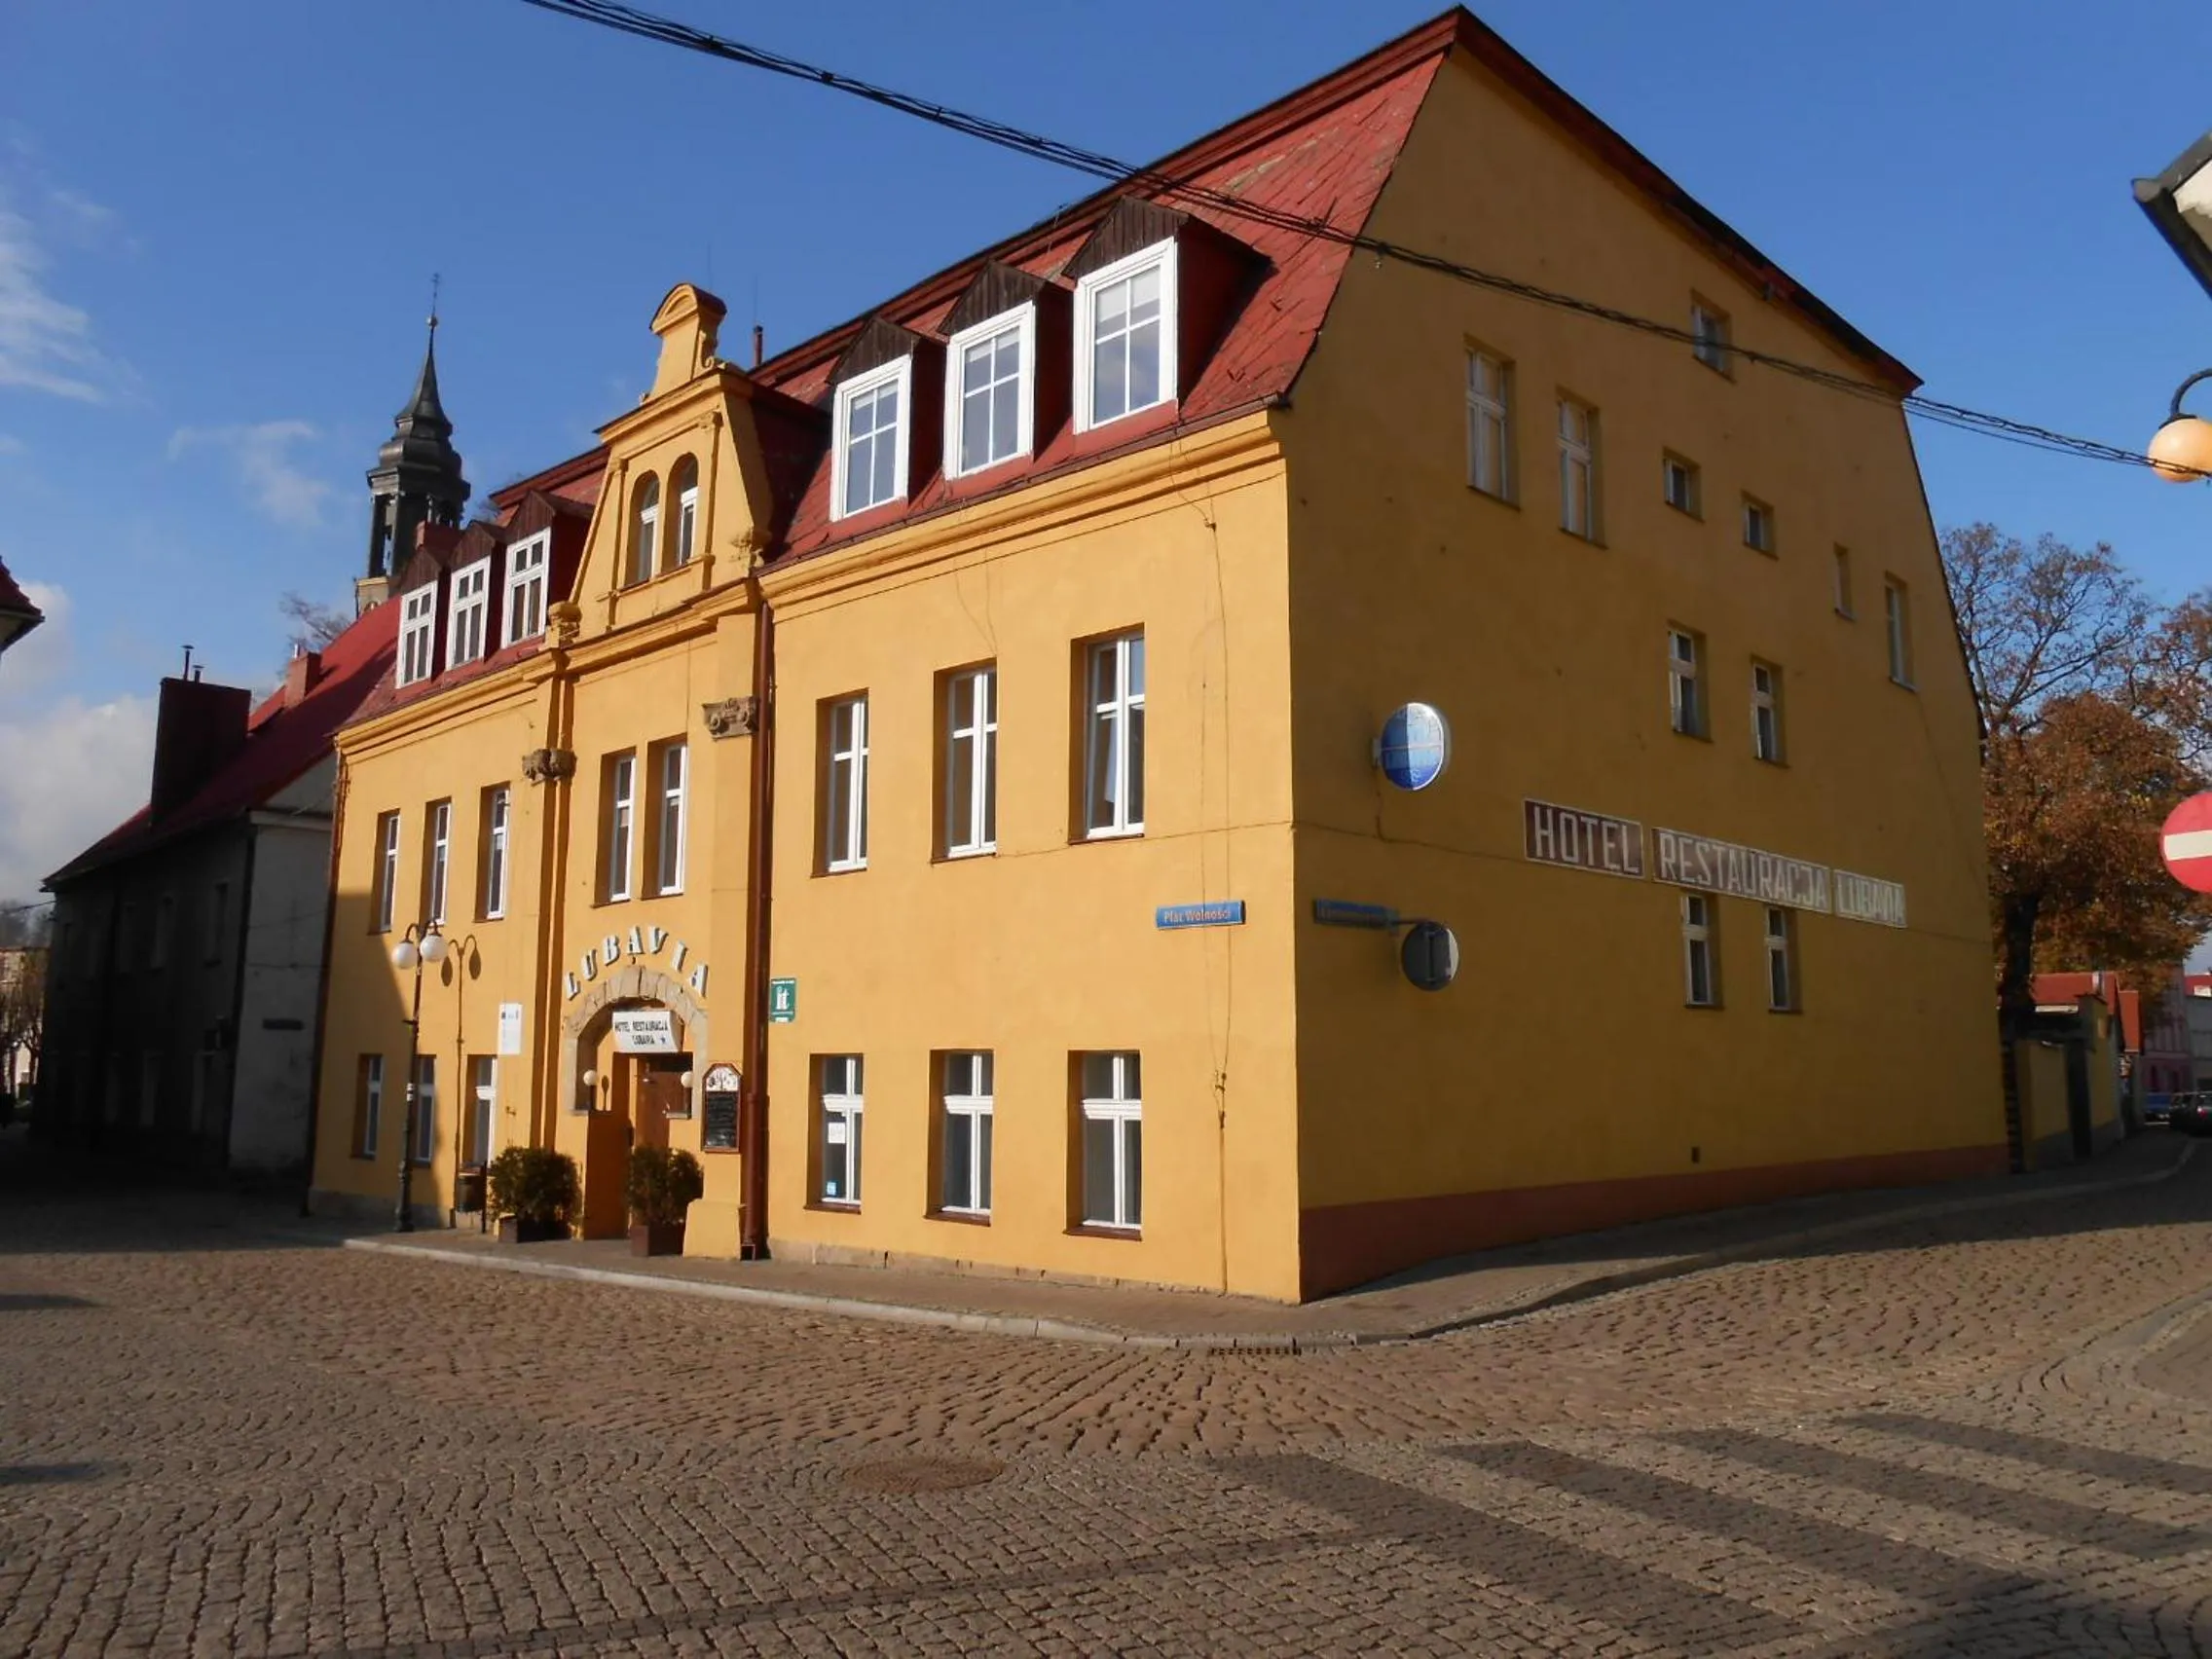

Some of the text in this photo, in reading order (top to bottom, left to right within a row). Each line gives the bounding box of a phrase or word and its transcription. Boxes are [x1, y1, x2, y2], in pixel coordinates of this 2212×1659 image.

[1533, 805, 1641, 874] HOTEL
[1659, 831, 1828, 909] RESTAURACJA
[566, 925, 709, 1000] LUBAVIA
